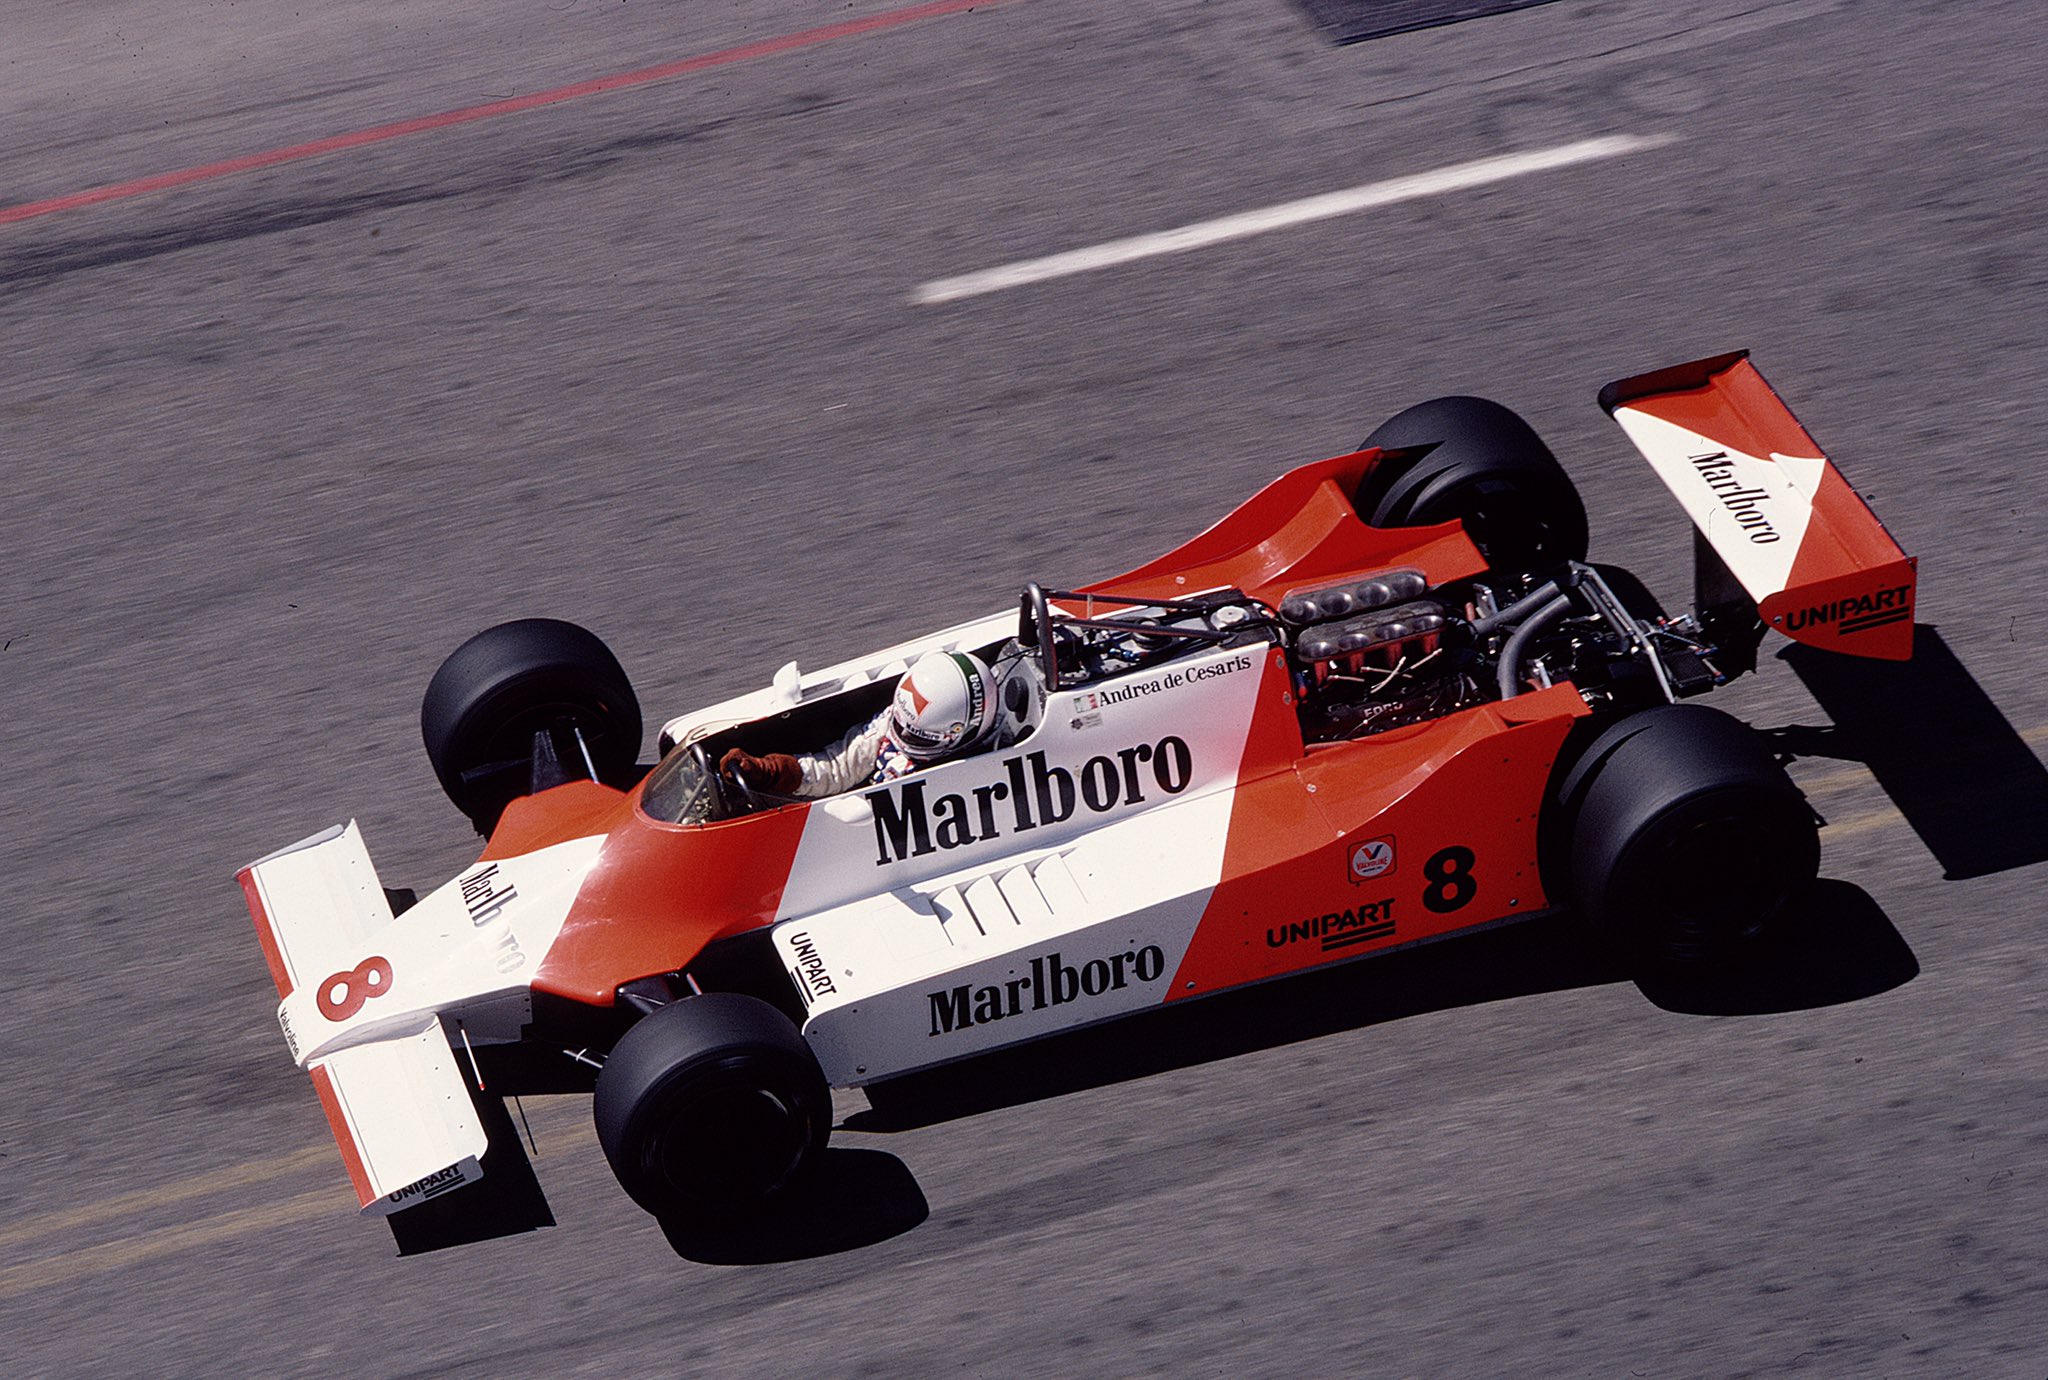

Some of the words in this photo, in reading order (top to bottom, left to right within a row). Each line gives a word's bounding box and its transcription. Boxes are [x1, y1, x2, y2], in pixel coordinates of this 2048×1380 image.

[1688, 451, 1781, 545] Marlboro
[1786, 584, 1911, 631] UNIPART
[969, 673, 984, 727] Andrea
[1100, 680, 1161, 707] Andrea
[1164, 673, 1184, 689] de
[1185, 656, 1252, 684] Cesaris
[906, 722, 941, 741] Marlboro
[865, 735, 1193, 866] Marlboro
[1422, 845, 1478, 914] 8
[1266, 898, 1396, 948] UNIPART
[316, 956, 394, 1022] 8
[790, 932, 837, 997] UNIPART
[928, 944, 1165, 1037] Marlboro
[280, 1007, 300, 1057] Valvoline
[388, 1163, 461, 1203] UNIPART
